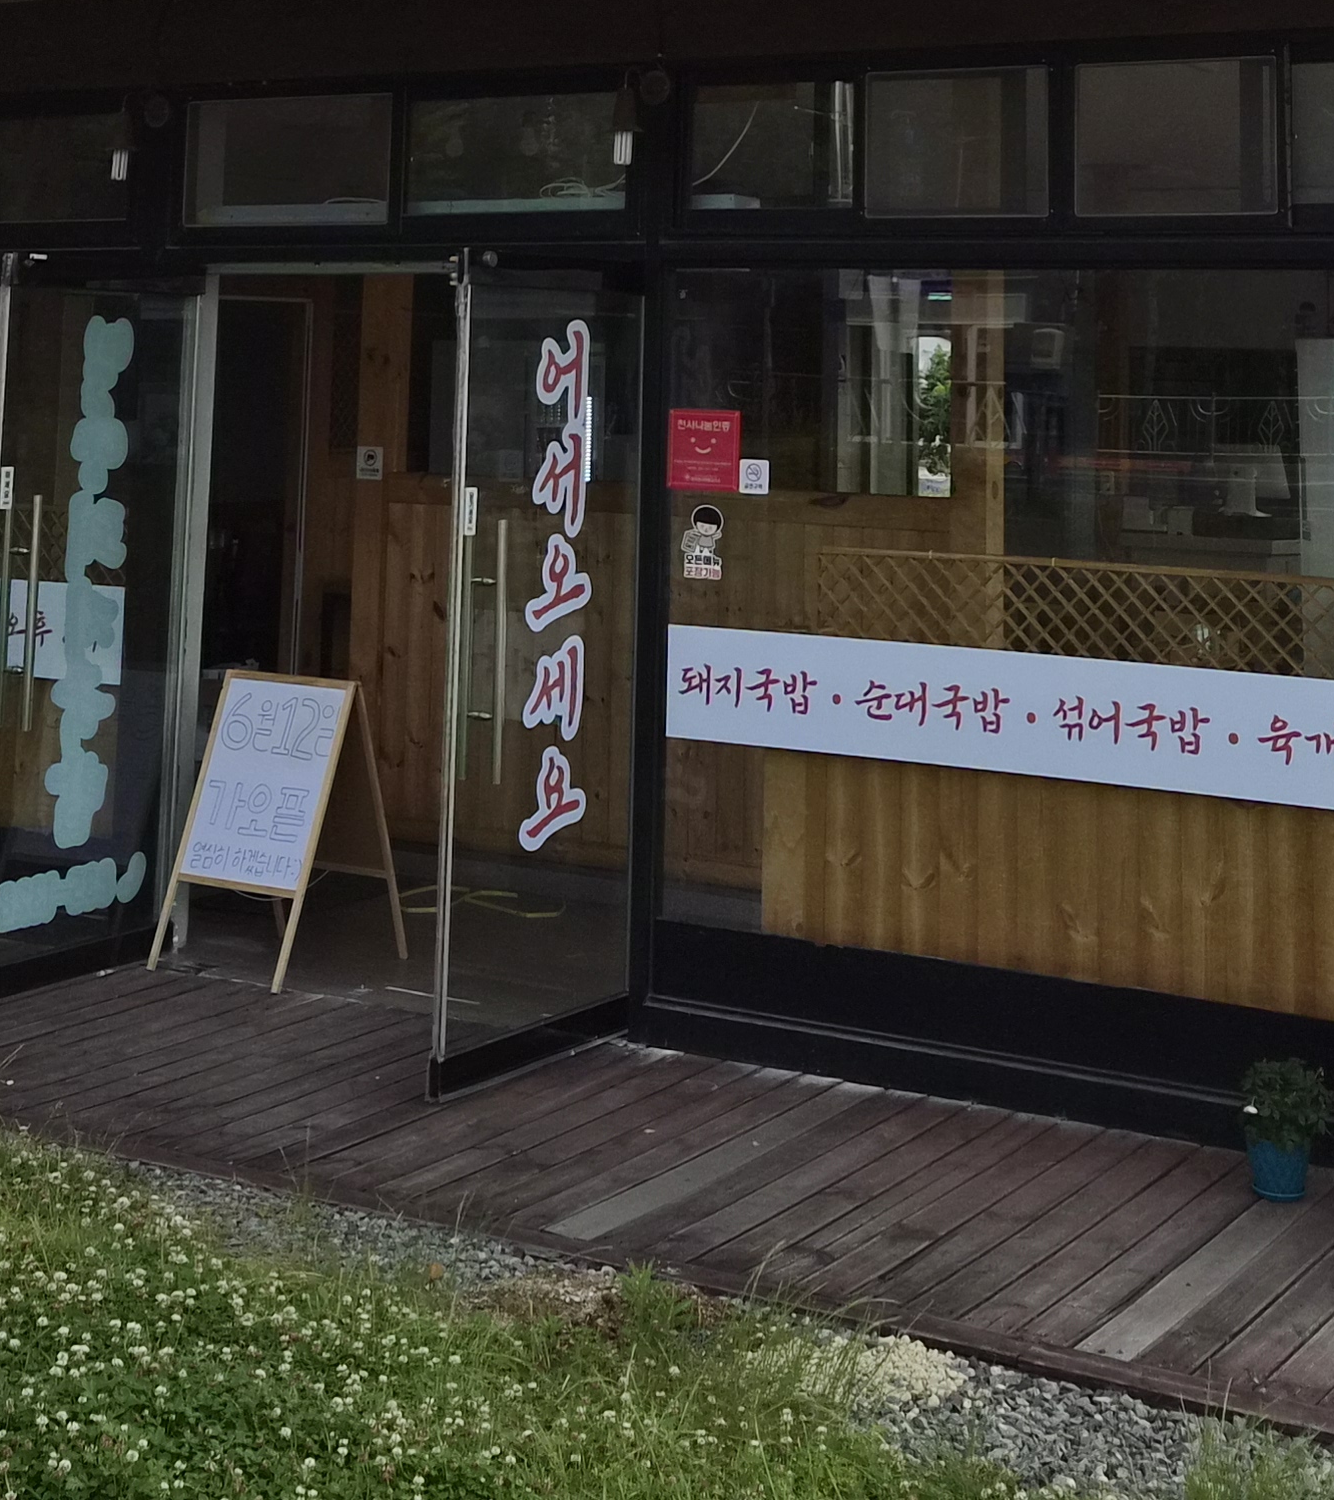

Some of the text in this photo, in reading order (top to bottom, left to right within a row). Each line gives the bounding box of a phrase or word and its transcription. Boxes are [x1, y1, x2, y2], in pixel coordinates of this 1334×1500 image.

[523, 326, 587, 842] 어서오세요
[677, 663, 818, 715] 돼지국밥
[853, 678, 1011, 735] 순대국밥
[1052, 694, 1211, 756] 섞어국밥
[208, 779, 311, 844] 가오픈
[190, 841, 231, 872] 열심히
